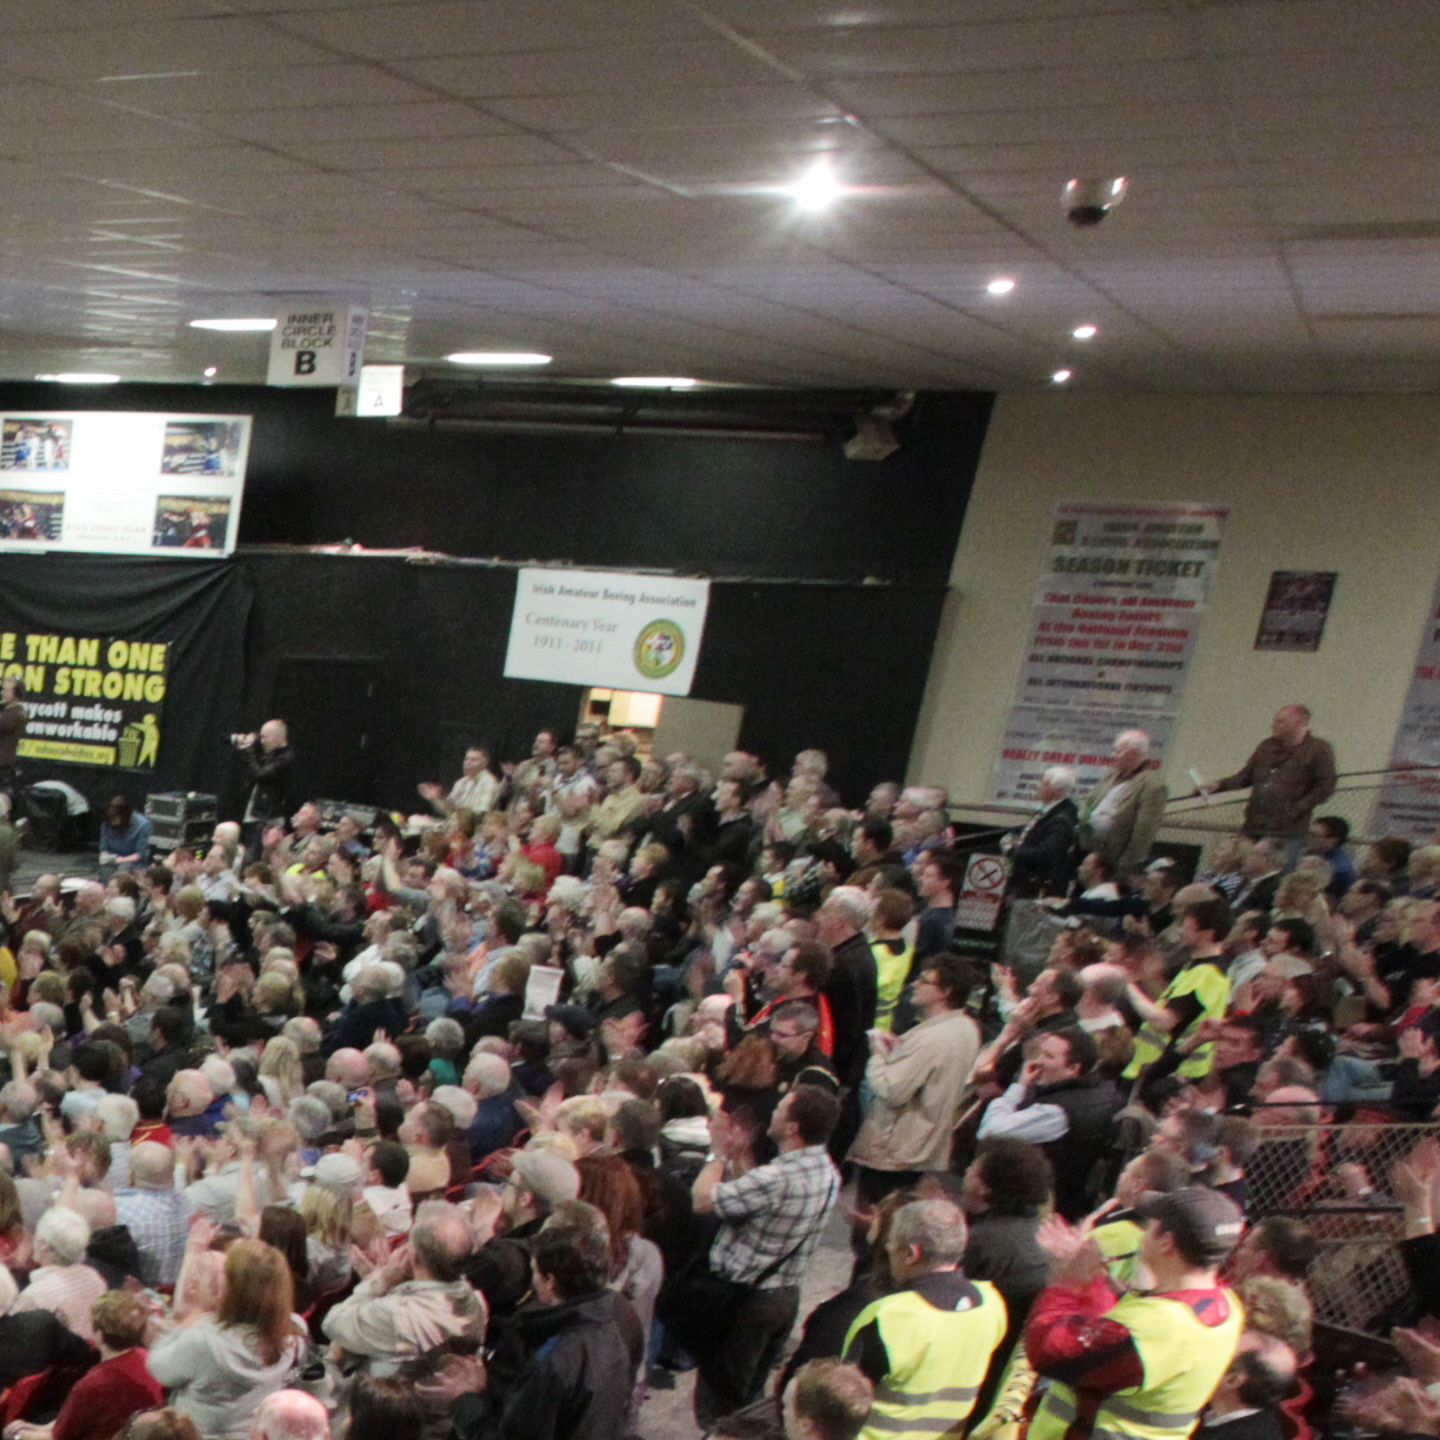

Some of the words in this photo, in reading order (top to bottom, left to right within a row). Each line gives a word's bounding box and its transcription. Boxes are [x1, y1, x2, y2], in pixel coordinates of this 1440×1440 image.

[287, 313, 334, 325] INNER
[281, 325, 336, 337] CIRCLE
[281, 338, 334, 349] BLOCK
[294, 350, 316, 376] B
[374, 395, 383, 408] A
[1053, 556, 1130, 575] SEASON
[1136, 558, 1205, 578] TICKET
[532, 584, 555, 594] Irish
[558, 586, 600, 599] Amateur
[603, 589, 635, 605] Boxing
[639, 592, 696, 608] Association
[526, 612, 589, 632] Centenary
[591, 618, 619, 632] Year
[26, 634, 100, 666] THAN
[108, 640, 167, 671] ONE
[533, 635, 561, 648] 1911
[573, 638, 604, 654] 2011
[54, 667, 166, 703] STRONG
[21, 701, 67, 719] oycott
[71, 703, 123, 724] makes
[25, 720, 118, 742] unworkable
